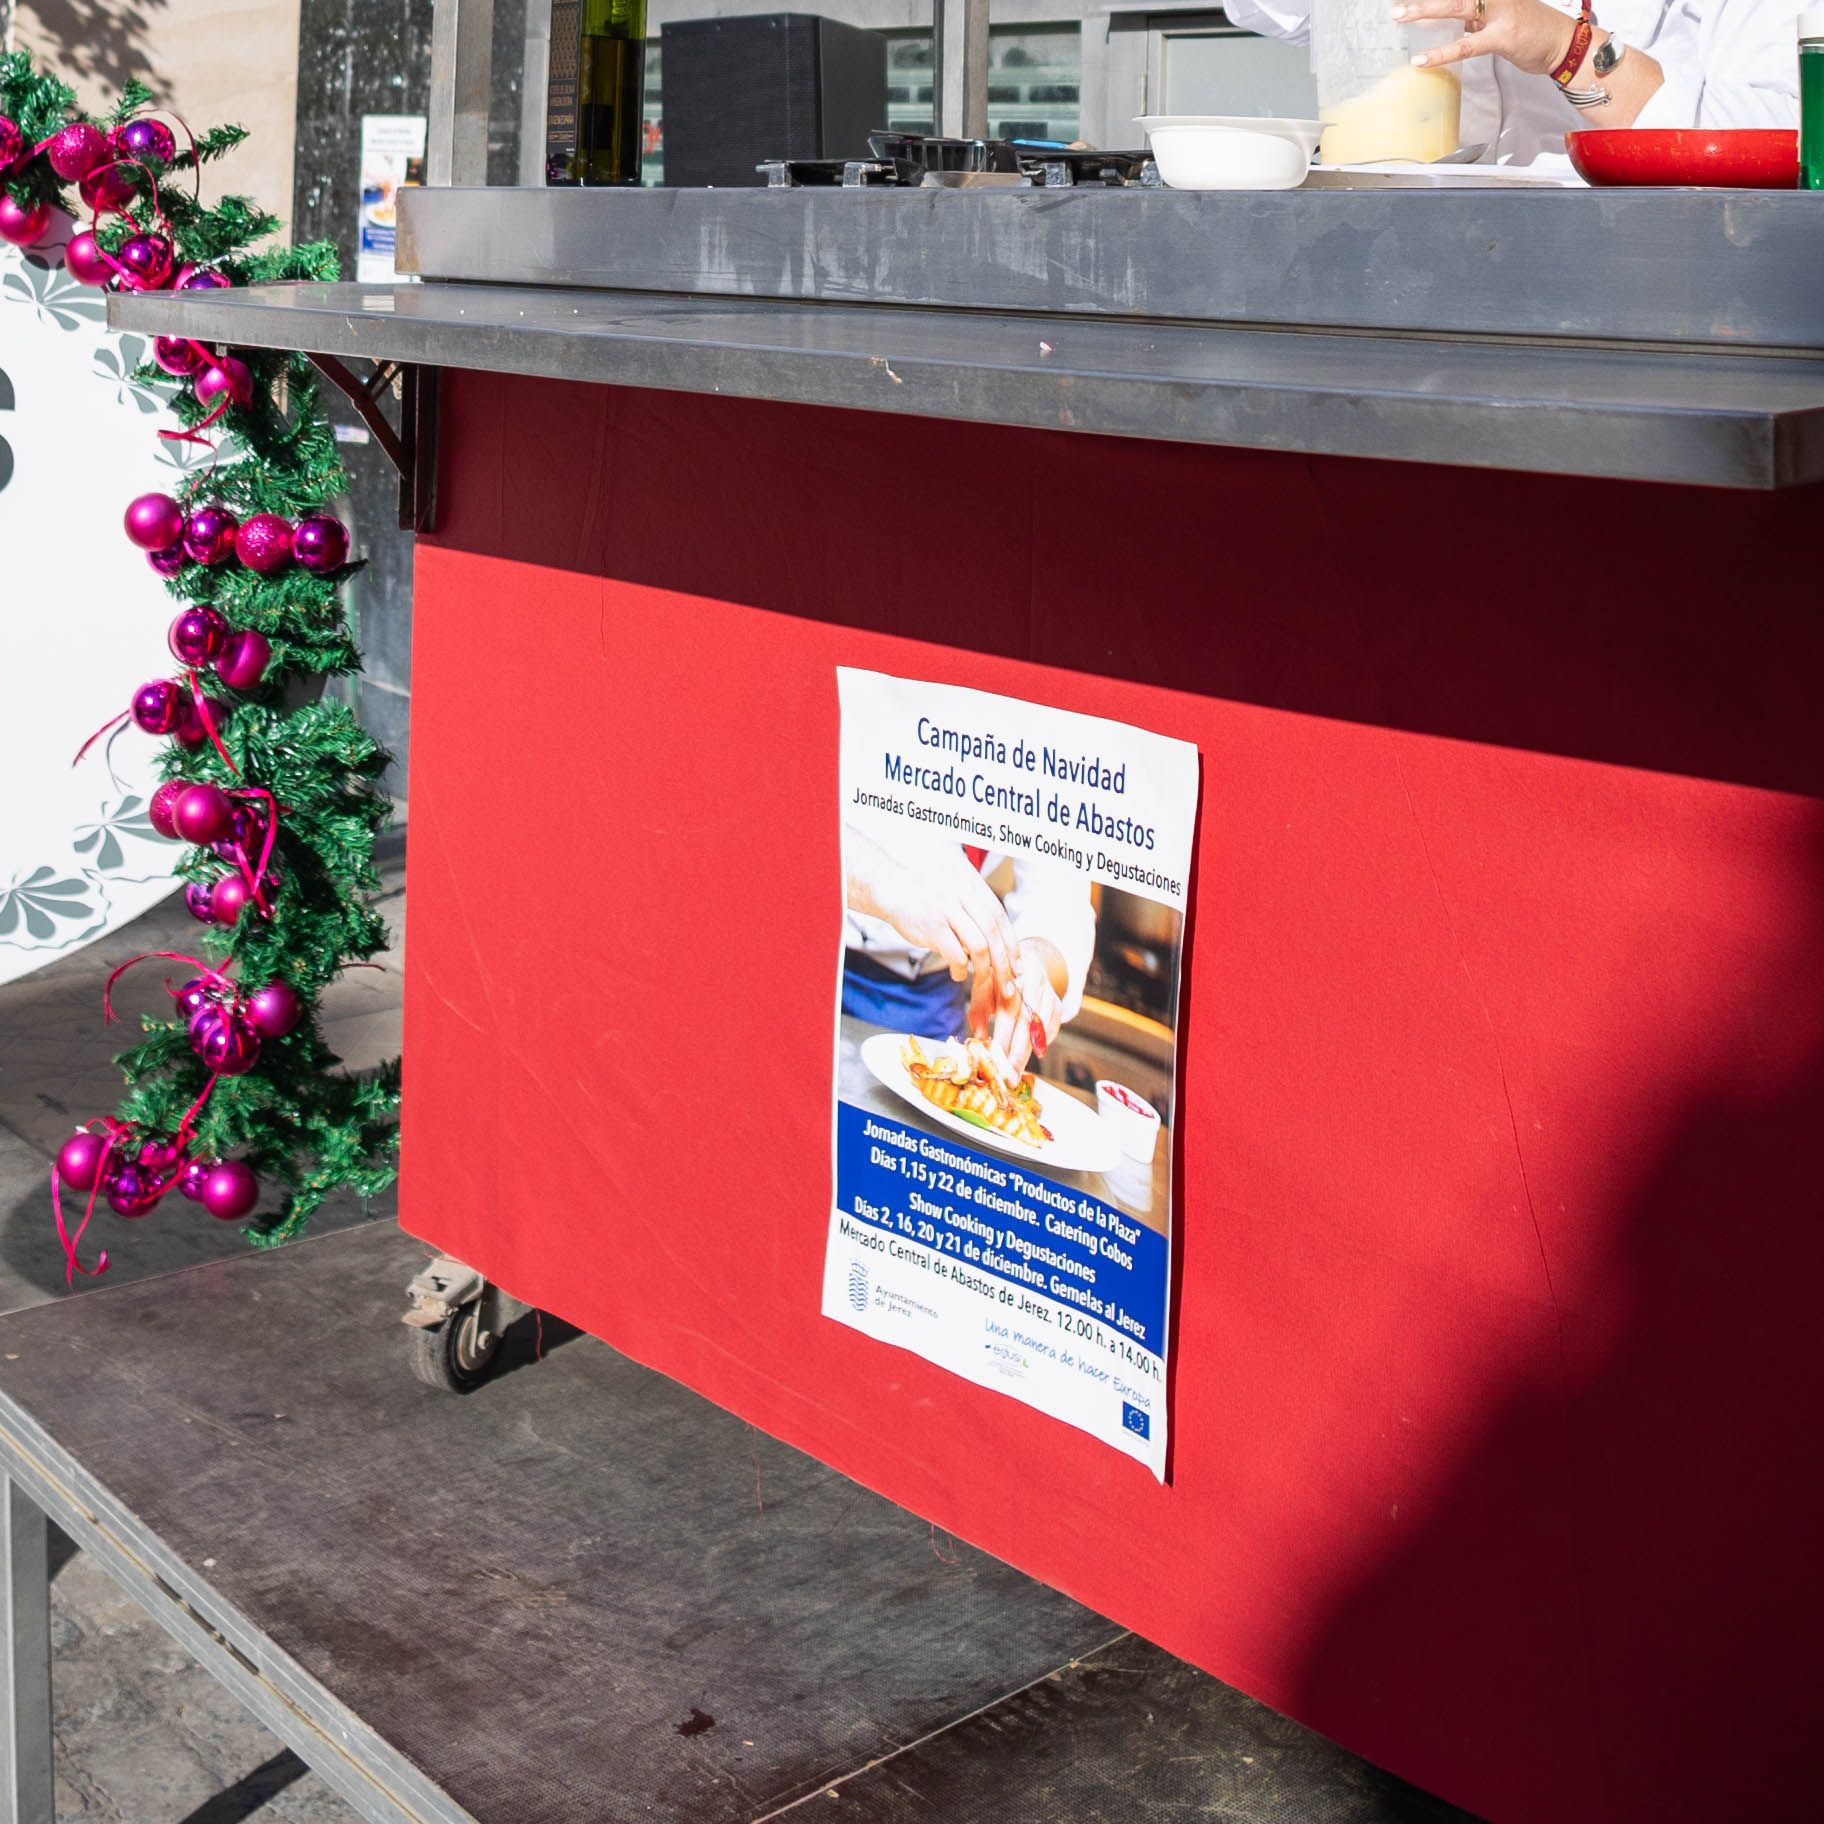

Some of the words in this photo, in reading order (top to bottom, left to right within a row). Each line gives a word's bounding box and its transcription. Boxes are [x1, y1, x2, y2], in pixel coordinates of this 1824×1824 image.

[885, 752, 966, 798] Mercado
[972, 774, 1040, 818] Central
[1047, 793, 1070, 826] de
[1076, 802, 1155, 851] Abastos
[917, 717, 1006, 764] Campaña
[1013, 739, 1036, 772] de
[1043, 747, 1126, 794] Navidad
[853, 787, 904, 815] Jornadas
[907, 800, 996, 841] Gastronómicas,
[999, 825, 1032, 849] Show
[1035, 834, 1082, 869] Cooking
[1086, 853, 1094, 872] y
[1097, 852, 1181, 896] Degustaciones
[863, 1119, 918, 1152] Jornadas
[919, 1138, 1007, 1187] Gastronómicas
[1078, 1199, 1094, 1222] de
[1096, 1205, 1107, 1229] la
[870, 1146, 897, 1172] Días
[928, 1172, 936, 1189] y
[938, 1171, 954, 1193] 22
[956, 1179, 973, 1200] de
[974, 1186, 1040, 1227] diciembre.
[1045, 1213, 1097, 1255] Catering
[1099, 1236, 1133, 1271] Cobos
[854, 1196, 879, 1221] Días
[880, 1207, 894, 1228] 2,
[897, 1213, 916, 1238] 16,
[917, 1221, 935, 1243] 20
[936, 1232, 944, 1250] y
[945, 1233, 961, 1254] 21
[963, 1240, 981, 1261] de
[982, 1247, 1048, 1290] diciembre.
[1049, 1275, 1103, 1314] Gemelas
[1104, 1302, 1115, 1322] al
[1116, 1308, 1146, 1340] Jerez
[909, 1192, 943, 1220] Show
[944, 1206, 995, 1245] Cooking
[995, 1231, 1005, 1249] y
[1006, 1230, 1096, 1284] Degustaciones
[839, 1218, 885, 1252] Mercado
[889, 1240, 931, 1270] Central
[933, 1258, 948, 1278] de
[951, 1265, 995, 1299] Abastos
[999, 1287, 1014, 1307] de
[1017, 1294, 1052, 1324] Jerez.
[1057, 1310, 1093, 1341] 12.00
[1096, 1326, 1106, 1349] h.
[1110, 1340, 1116, 1354] a
[1119, 1341, 1150, 1375] 14.00
[1152, 1360, 1162, 1382] h.
[875, 1285, 939, 1318] Ayuntamiento
[984, 1317, 1009, 1338] Una
[1013, 1331, 1057, 1360] manera
[1059, 1349, 1075, 1368] de
[1078, 1356, 1110, 1384] hacer
